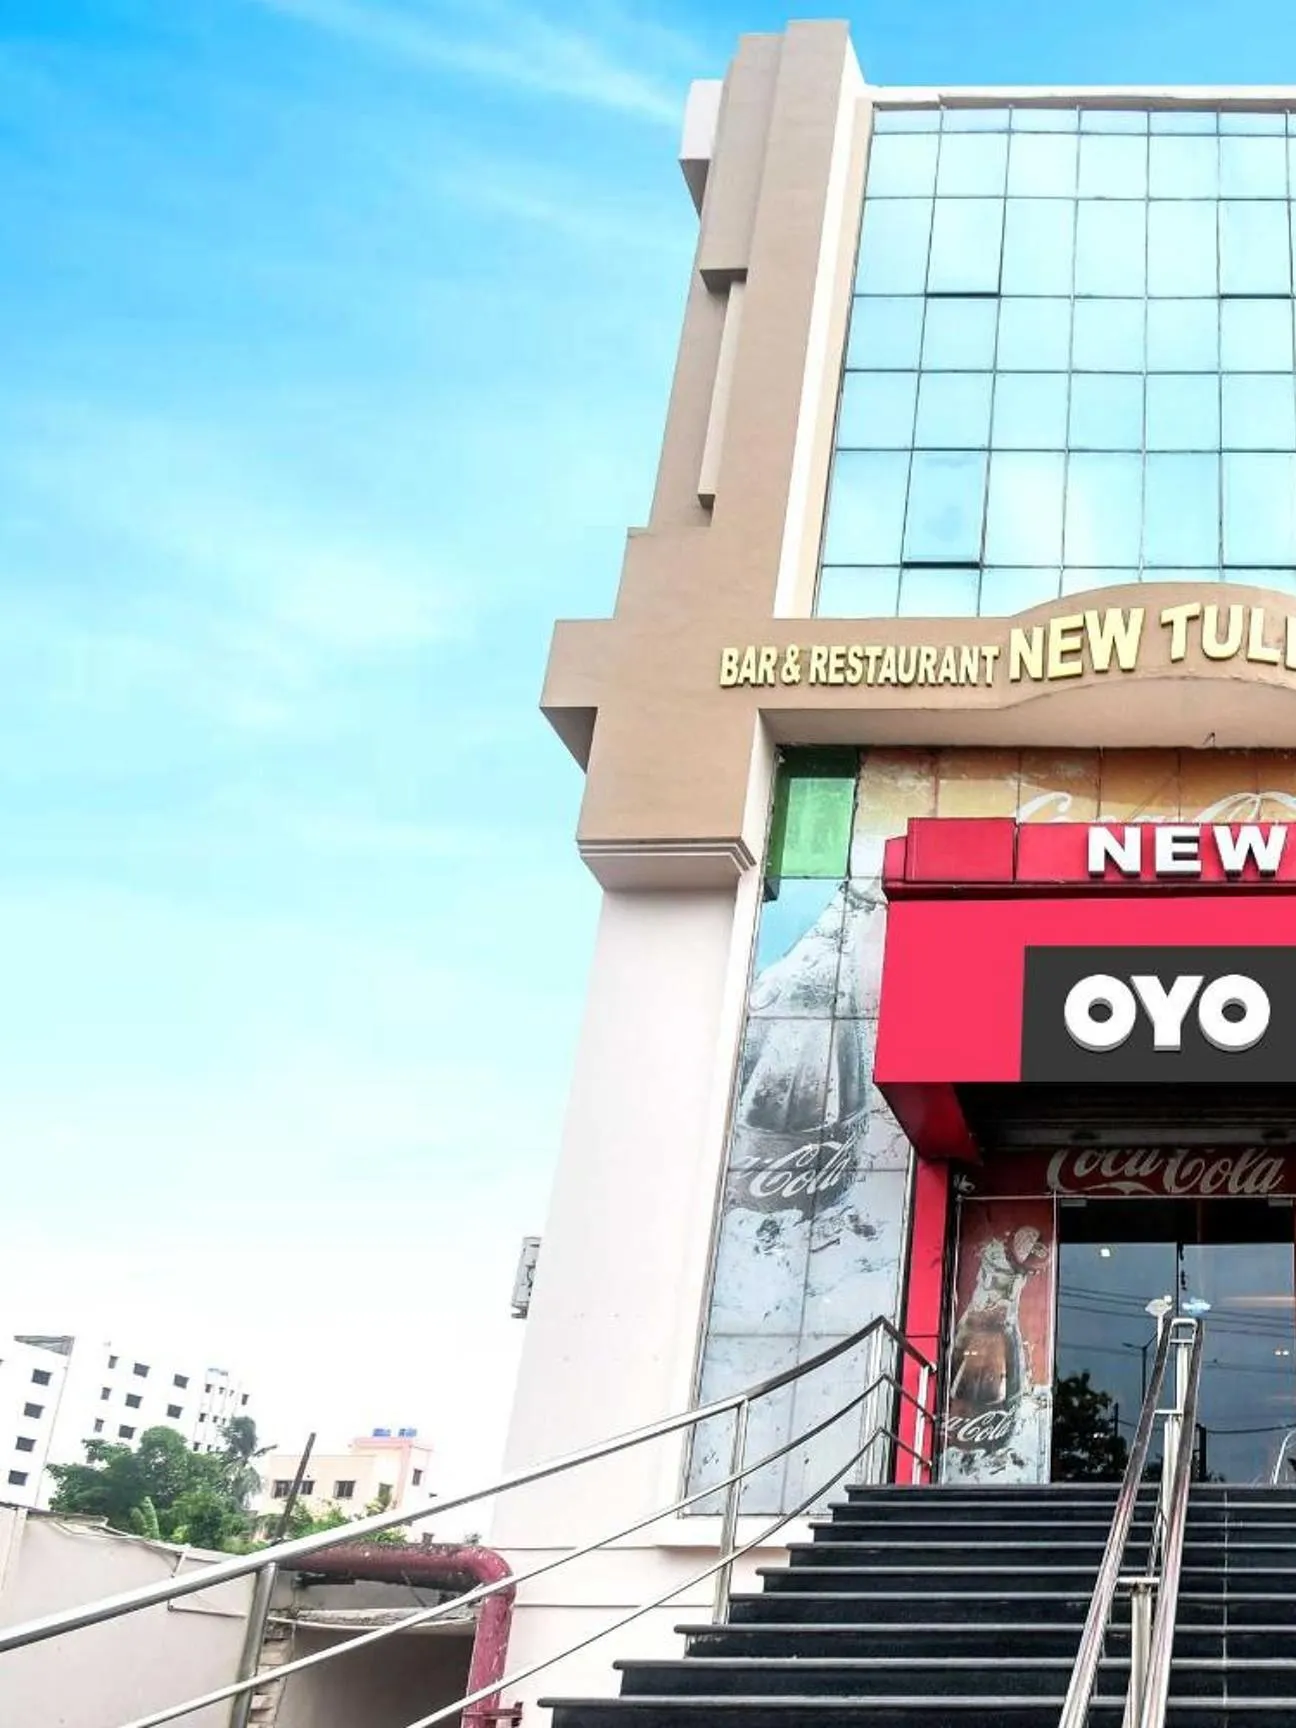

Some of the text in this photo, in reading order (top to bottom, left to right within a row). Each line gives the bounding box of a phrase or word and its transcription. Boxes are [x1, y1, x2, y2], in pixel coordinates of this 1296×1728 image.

[720, 644, 1000, 688] BAR & RESTAURANT
[1009, 607, 1145, 682] NEW
[1086, 825, 1289, 878] NEW
[1063, 973, 1271, 1053] OYO
